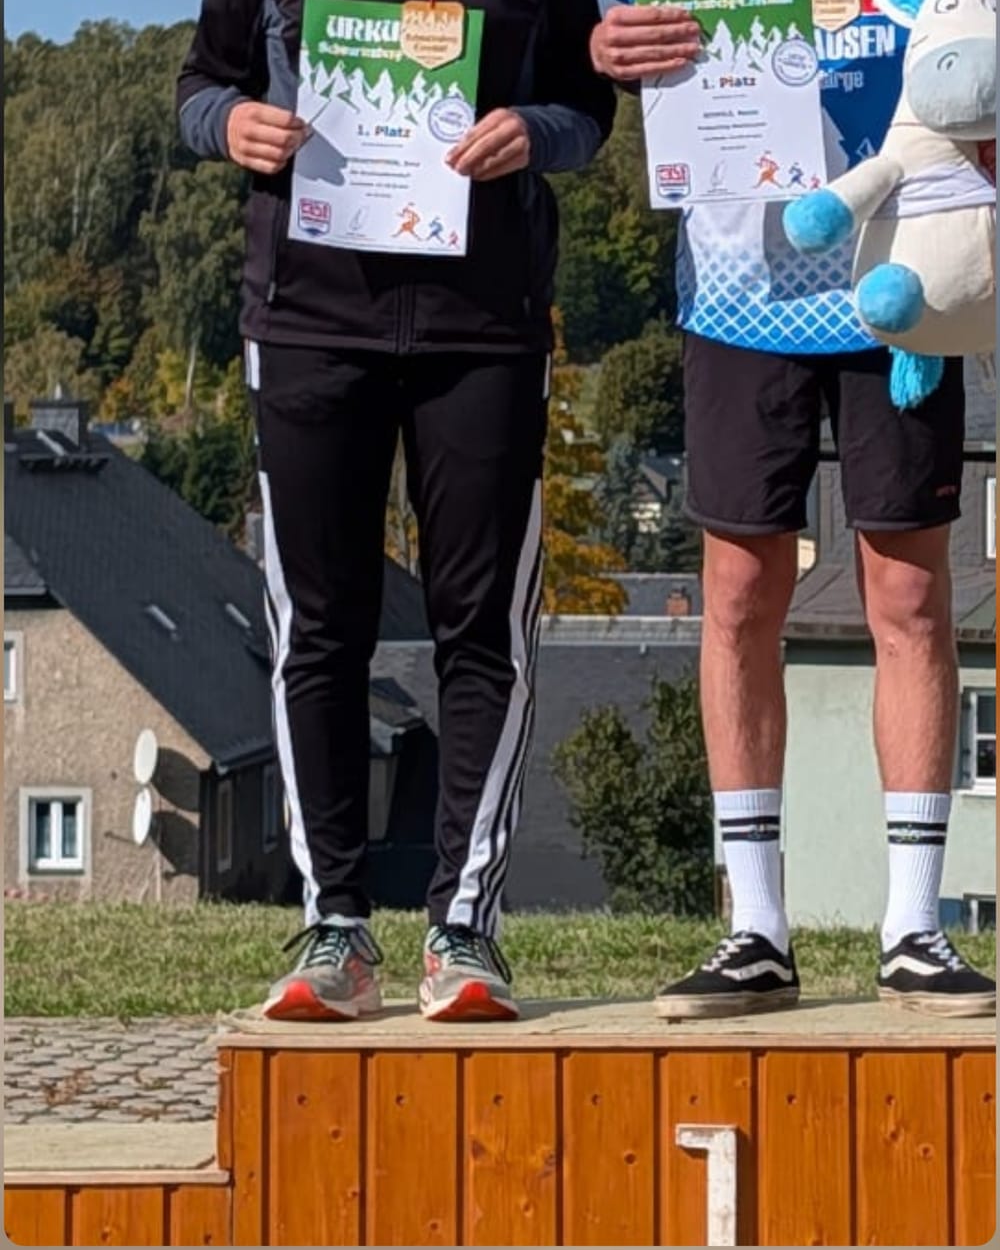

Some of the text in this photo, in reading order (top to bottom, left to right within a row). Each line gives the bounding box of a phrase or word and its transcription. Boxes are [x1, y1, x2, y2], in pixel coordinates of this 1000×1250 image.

[719, 76, 757, 88] Platz
[358, 124, 412, 138] 1. Platz
